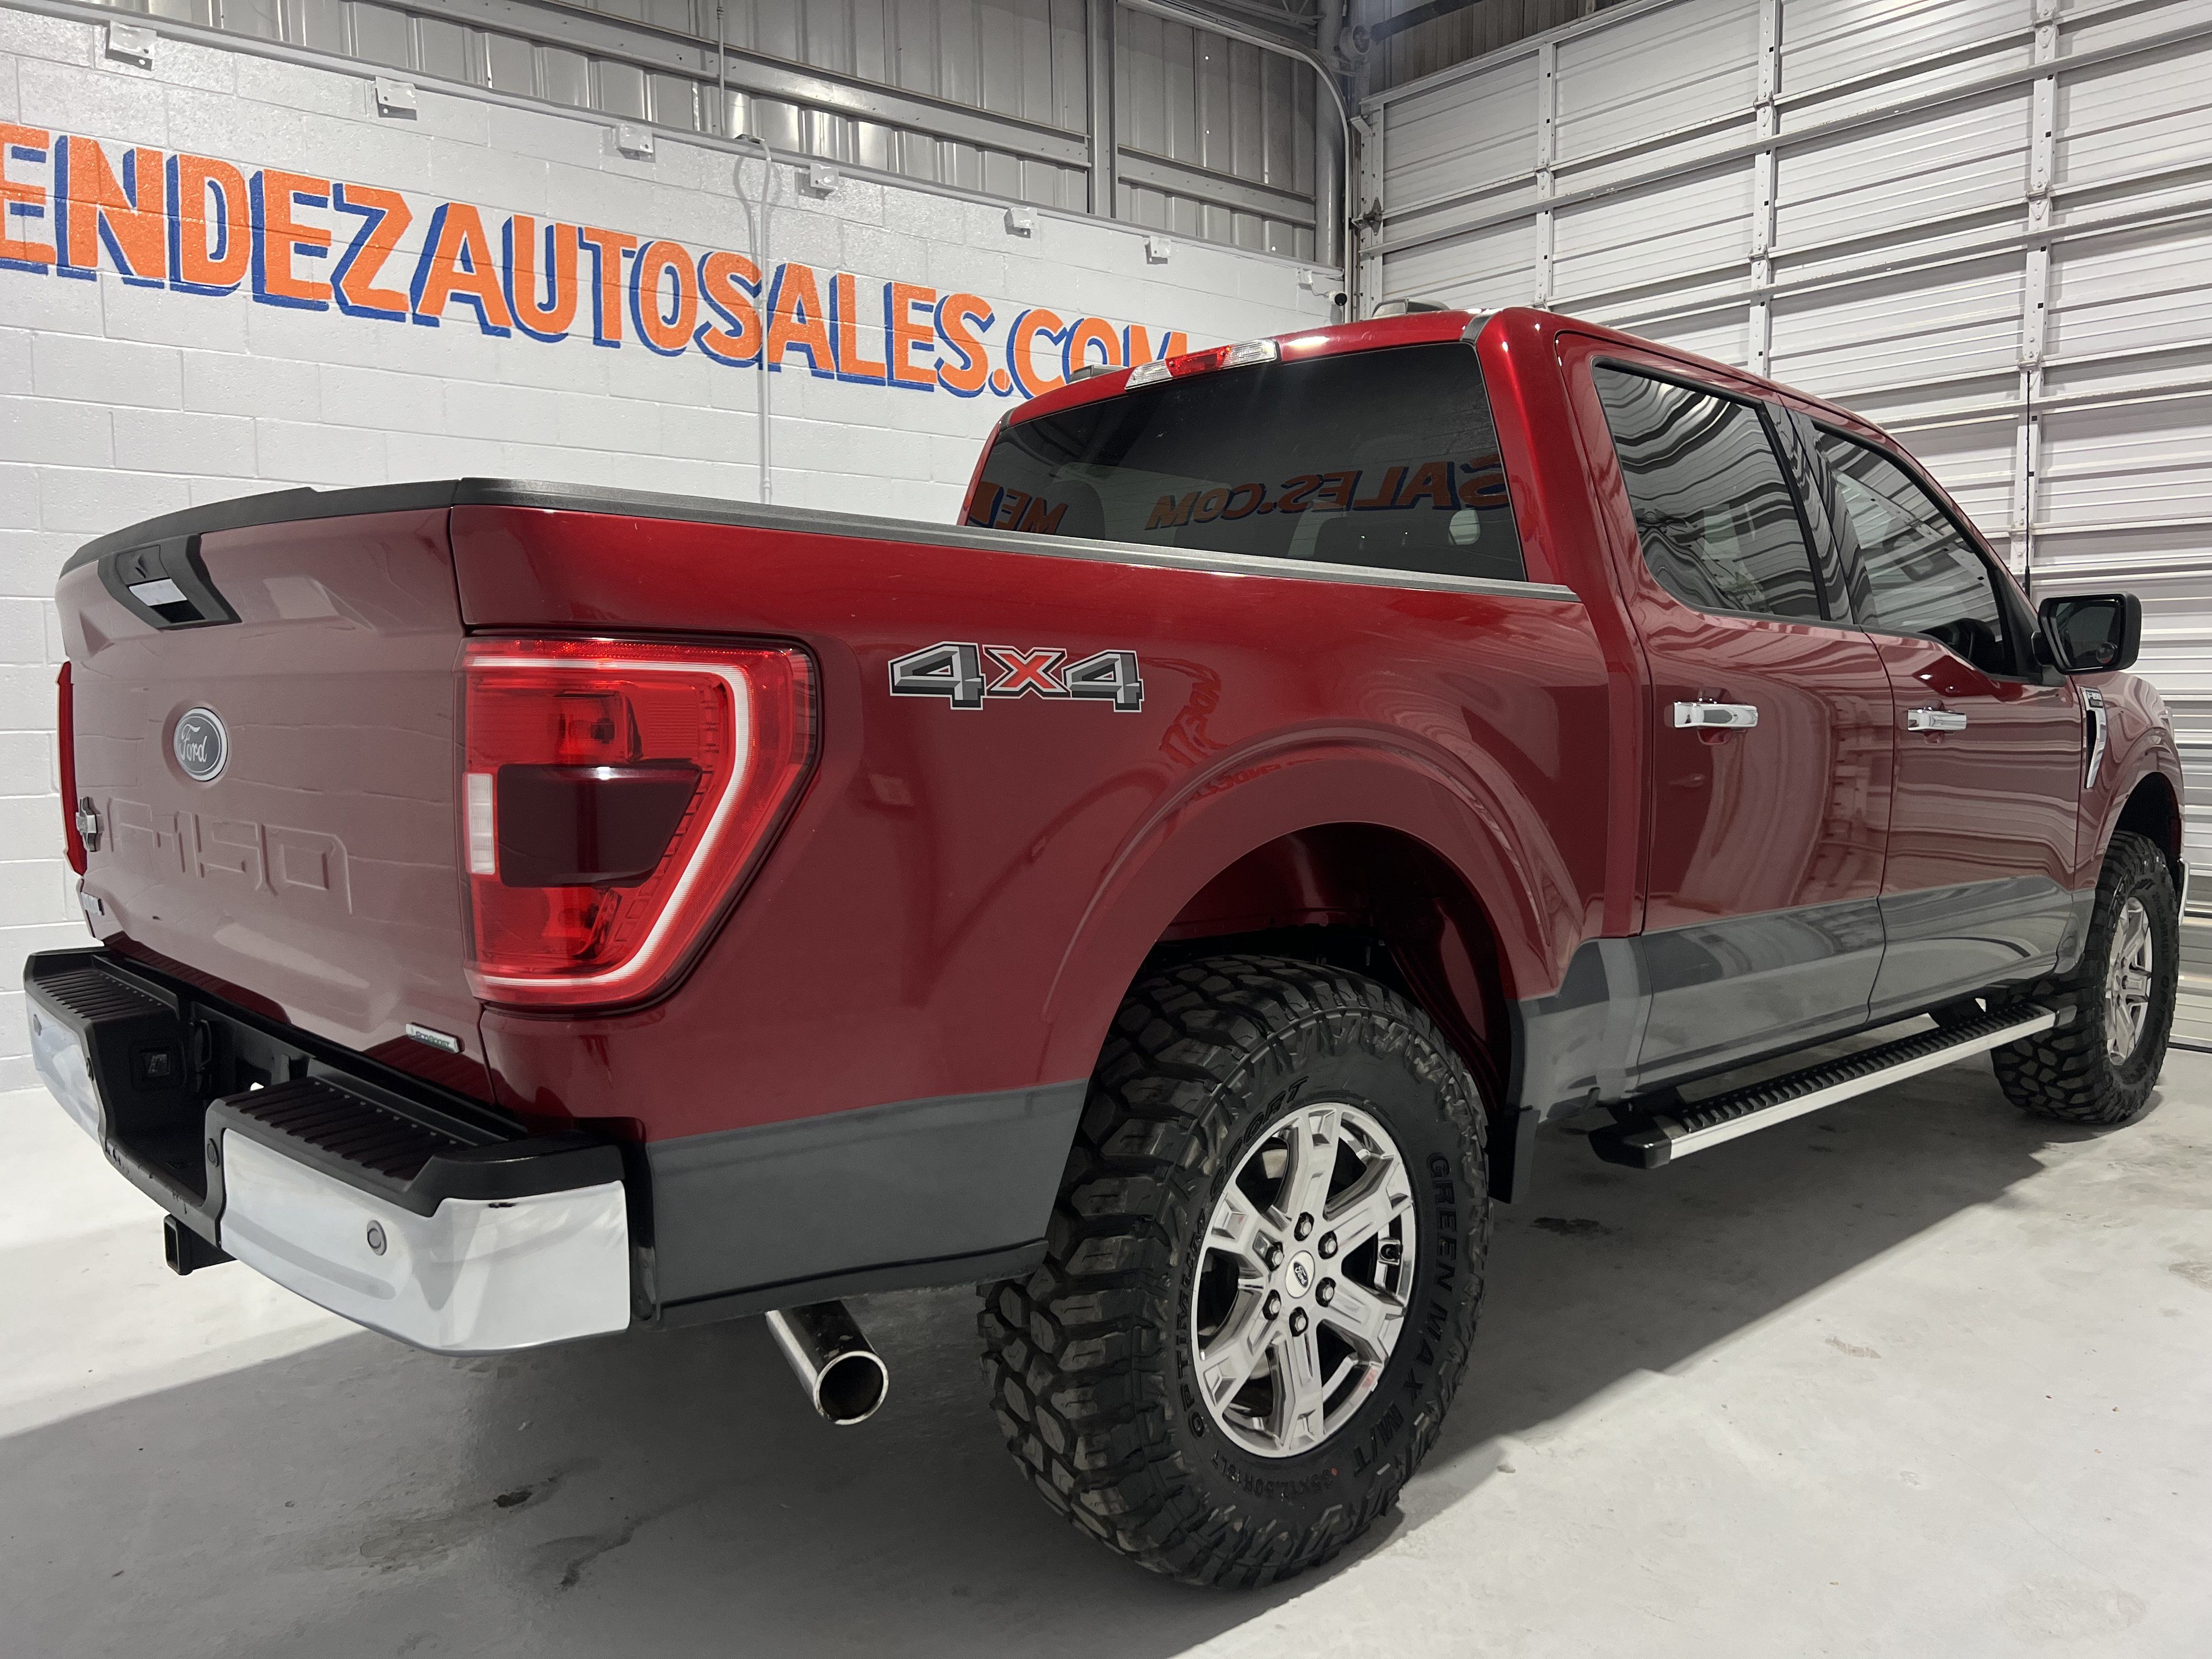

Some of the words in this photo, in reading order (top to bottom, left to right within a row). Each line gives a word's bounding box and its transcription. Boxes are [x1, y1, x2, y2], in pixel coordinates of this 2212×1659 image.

[1427, 1152, 1458, 1292] GREEN
[1403, 1299, 1448, 1408] MAX
[1352, 1400, 1404, 1478] M/T
